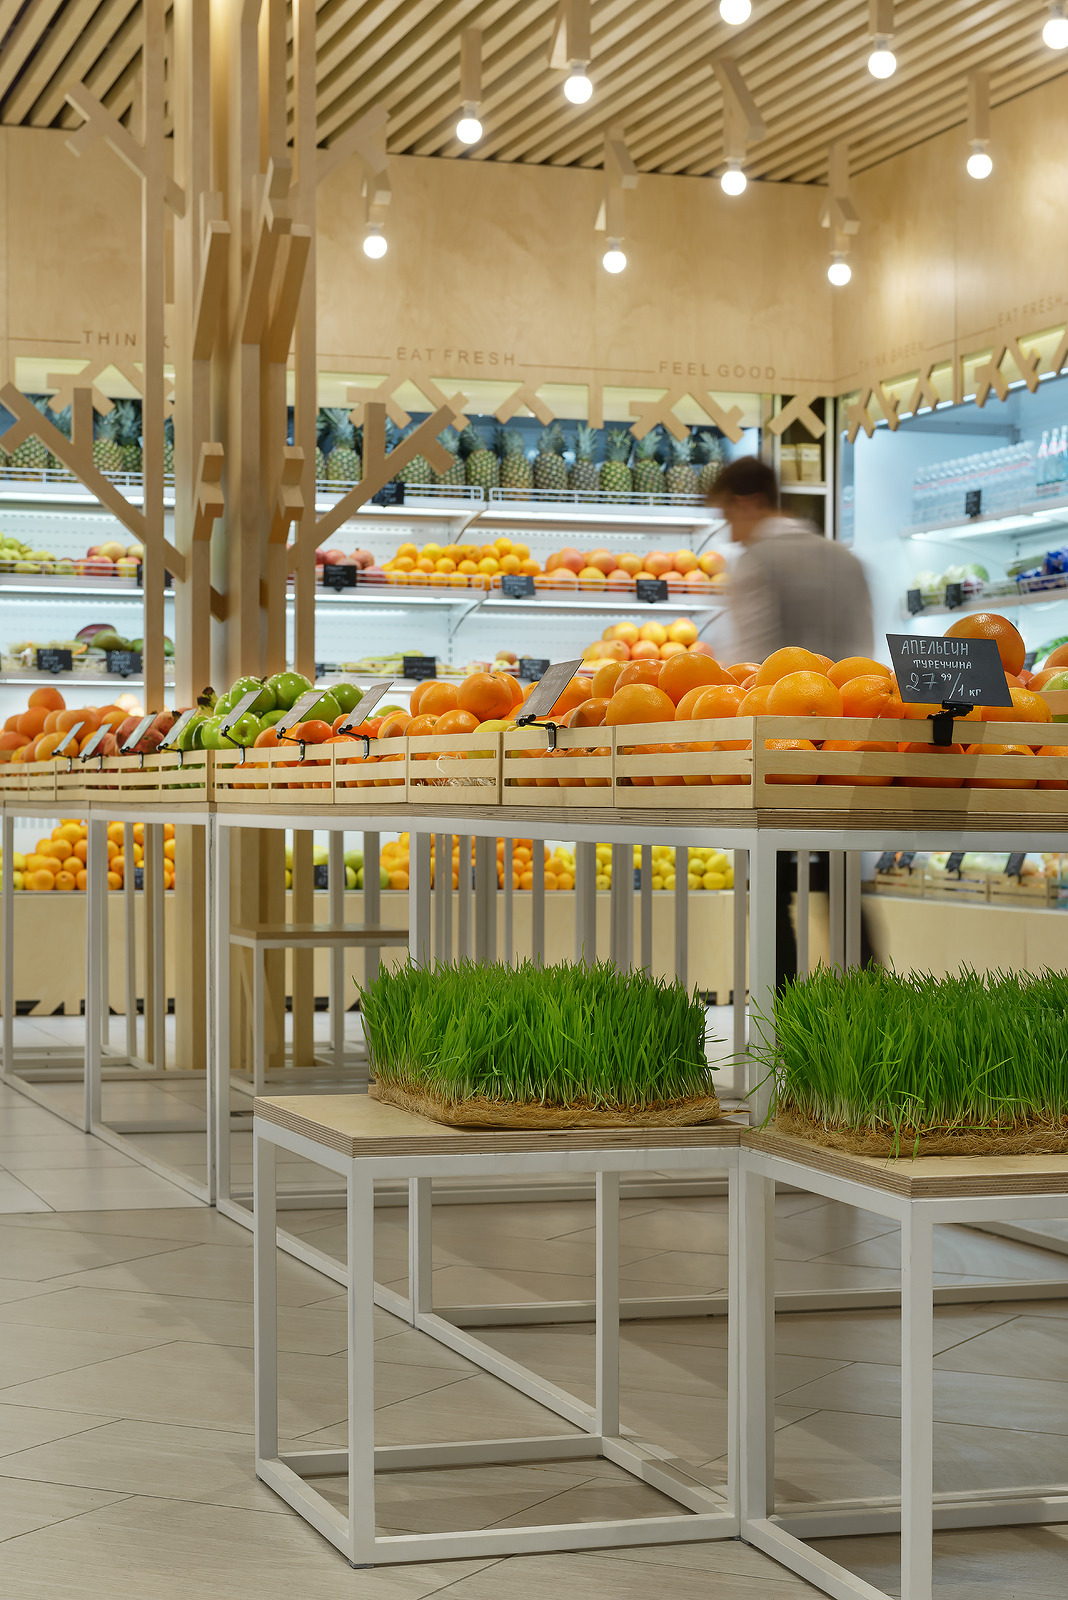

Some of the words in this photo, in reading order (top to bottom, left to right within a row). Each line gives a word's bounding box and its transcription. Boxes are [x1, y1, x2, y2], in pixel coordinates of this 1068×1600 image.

[82, 330, 150, 347] THIN
[396, 346, 435, 361] EAT
[443, 349, 515, 366] FRESH
[659, 360, 710, 377] FEEL
[717, 364, 776, 380] GOOD
[901, 639, 969, 656] АПЕЛЬСИН
